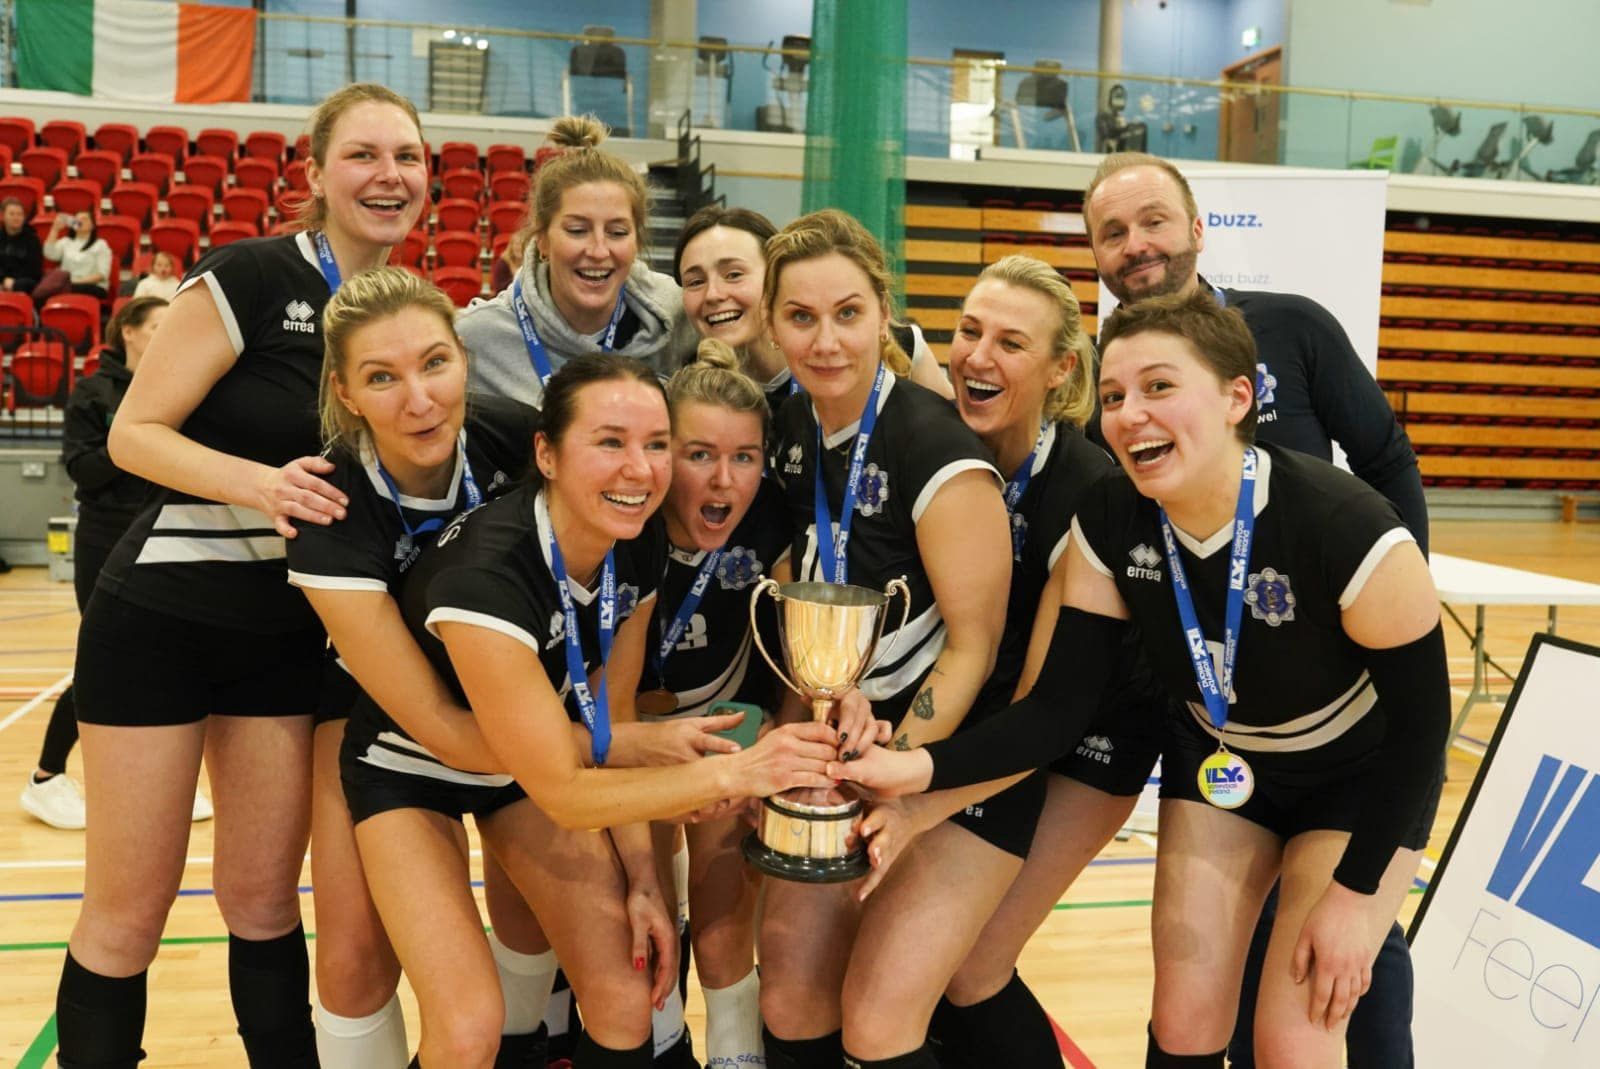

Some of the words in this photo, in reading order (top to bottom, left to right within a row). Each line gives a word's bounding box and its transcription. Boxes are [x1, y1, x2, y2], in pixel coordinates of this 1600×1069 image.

[1207, 212, 1263, 228] buzz.
[283, 319, 315, 334] errea
[1127, 565, 1162, 582] errea
[1076, 745, 1111, 764] errea
